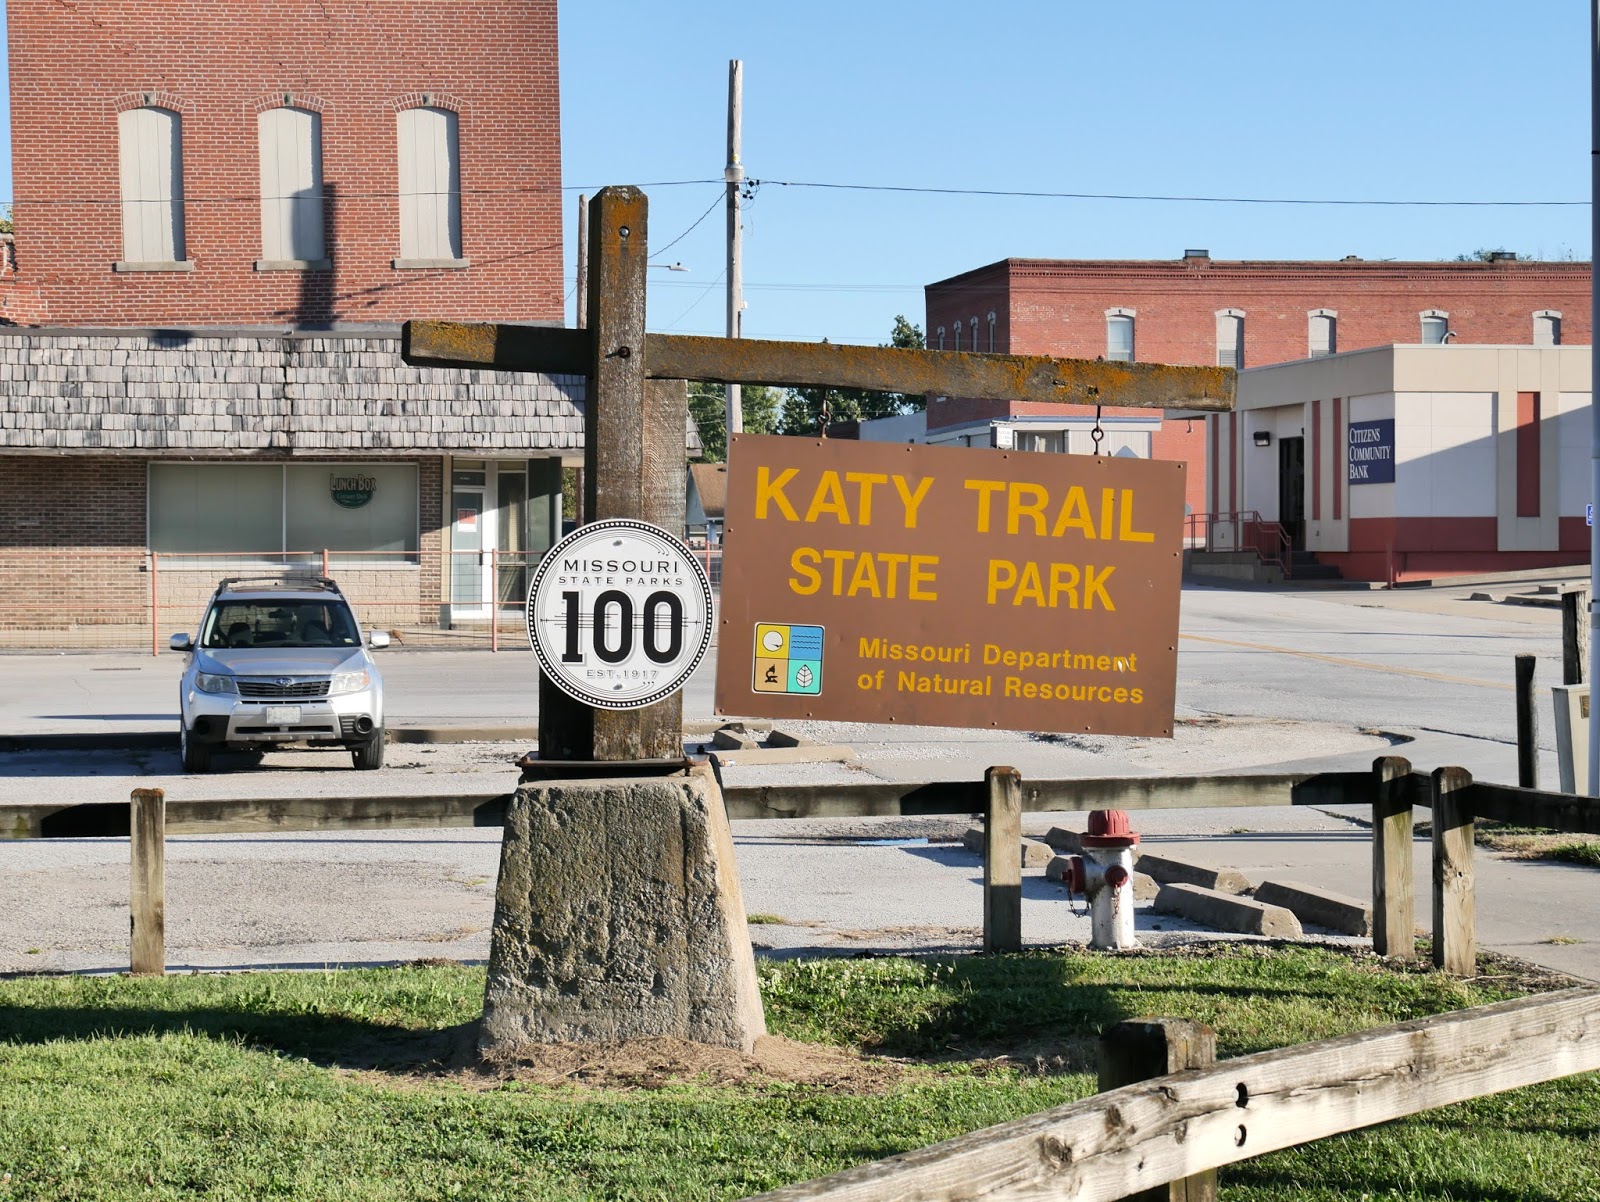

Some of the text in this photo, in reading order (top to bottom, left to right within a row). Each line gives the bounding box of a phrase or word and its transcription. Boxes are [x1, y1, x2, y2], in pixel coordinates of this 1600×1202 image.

[1350, 428, 1380, 443] CITIZENS
[1350, 446, 1391, 461] COMMUNITY
[1350, 464, 1369, 479] BANK
[755, 466, 1155, 543] KATY TRAIL
[564, 559, 679, 573] MISSOURI
[558, 576, 683, 586] STATE PARKS
[788, 547, 1116, 611] STATE PARK
[561, 589, 683, 664] 100
[858, 637, 1138, 673] Missouri Department
[857, 670, 1145, 704] of Natural Resources
